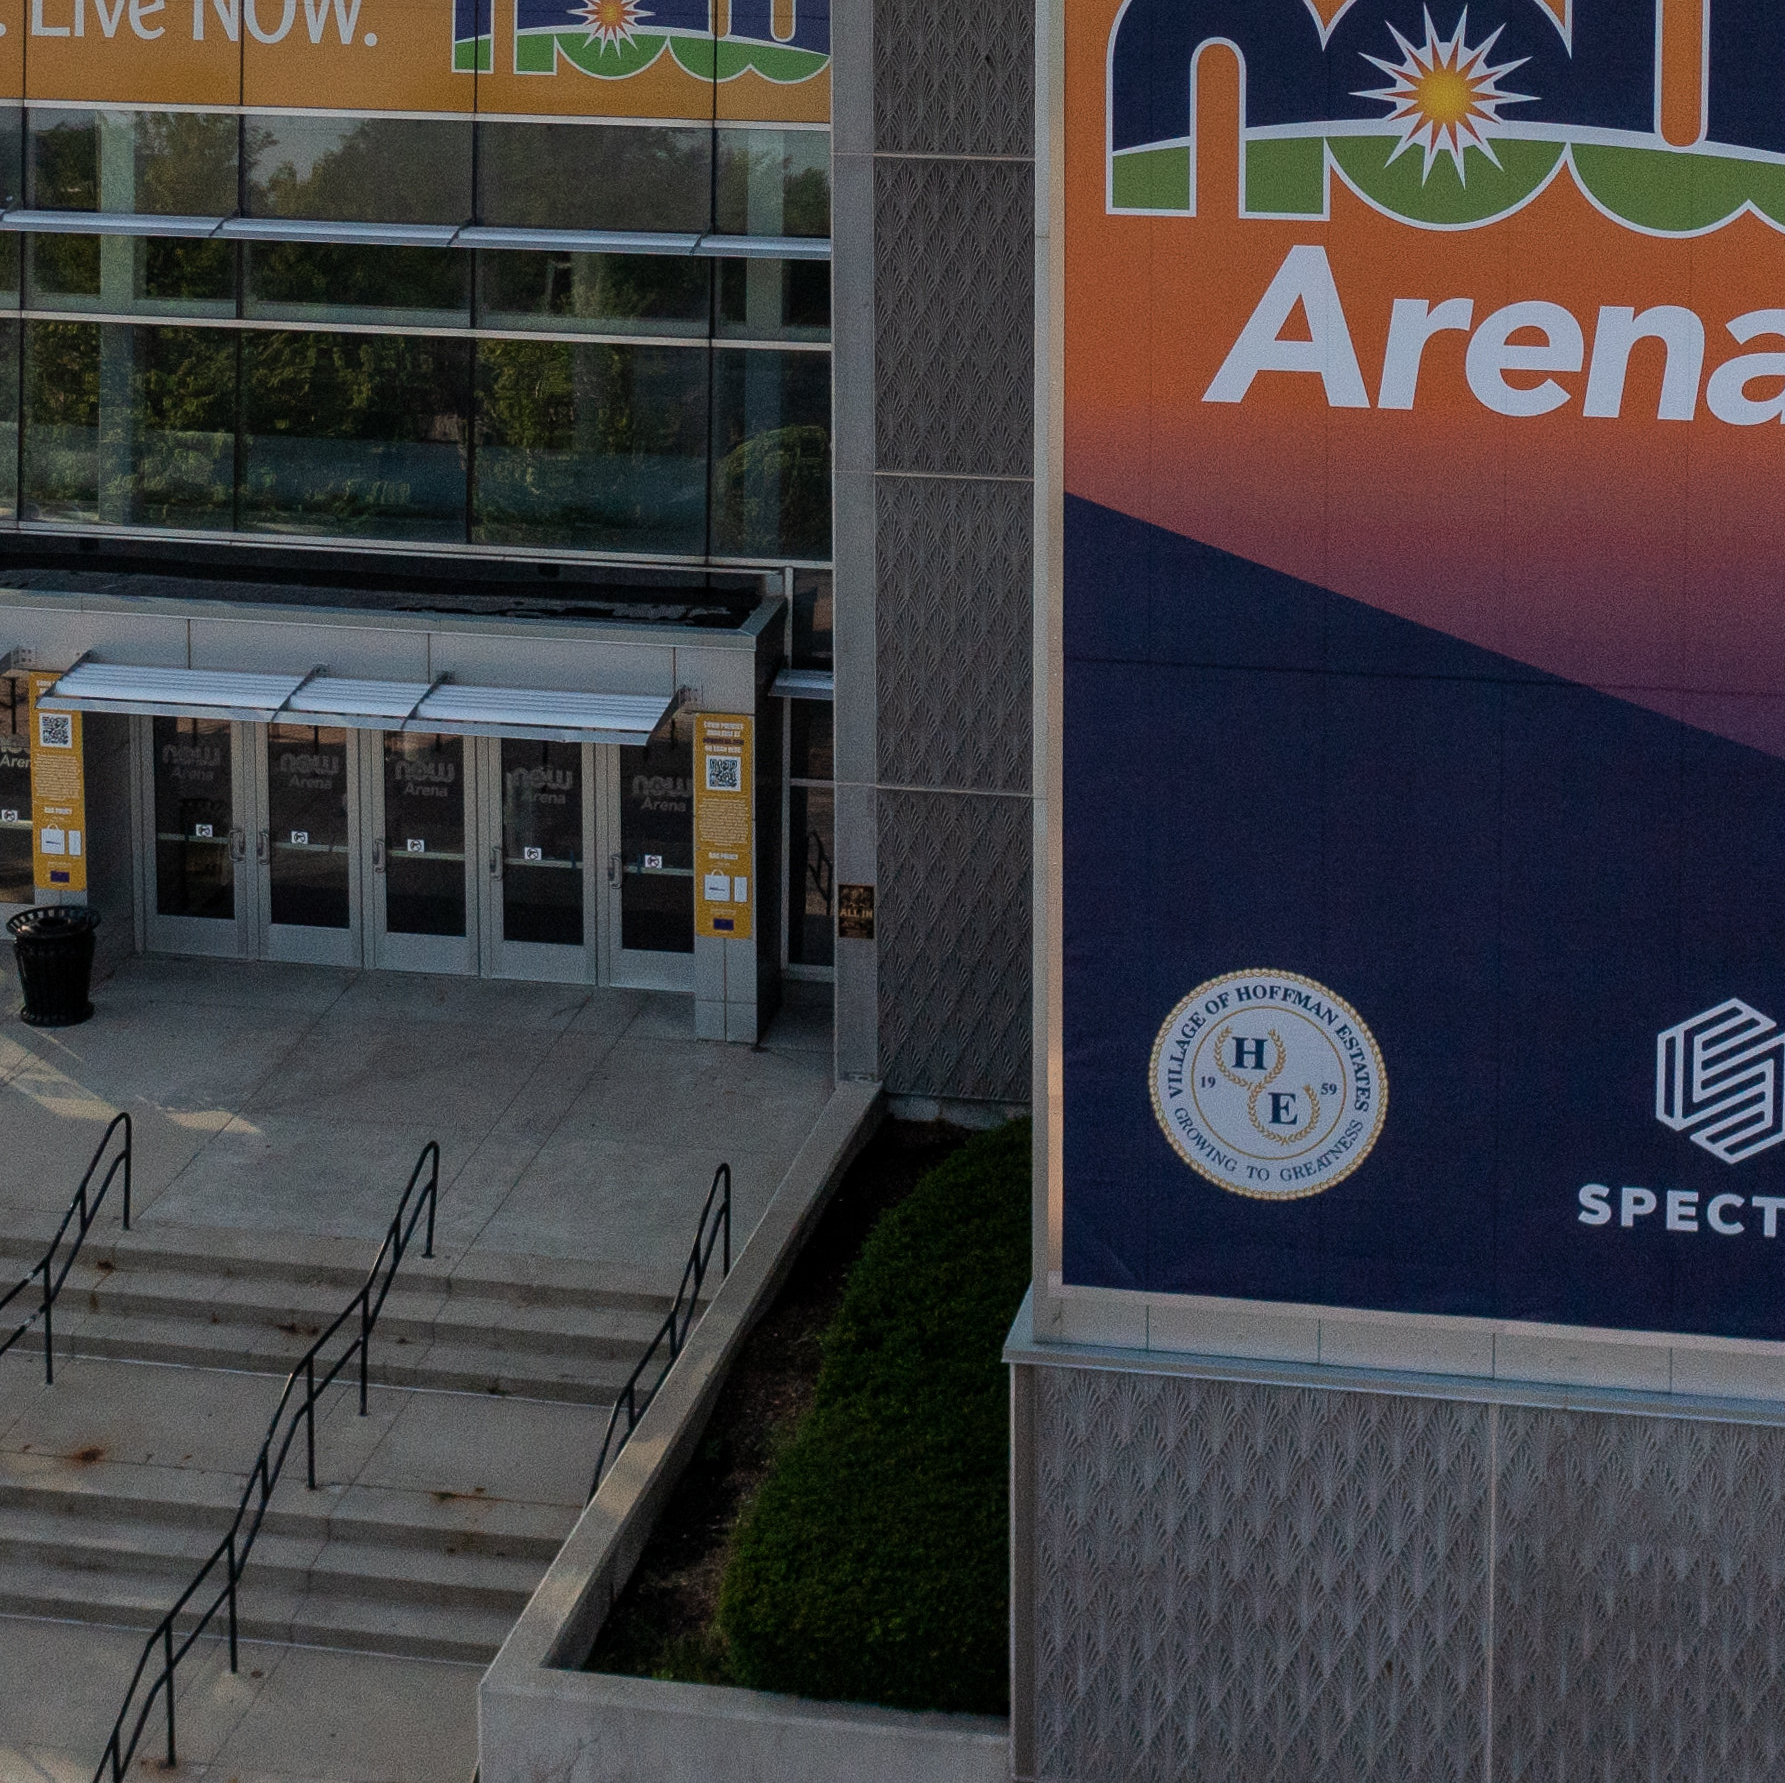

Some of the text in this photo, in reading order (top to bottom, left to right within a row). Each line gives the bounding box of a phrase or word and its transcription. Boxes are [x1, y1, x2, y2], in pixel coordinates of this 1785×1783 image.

[1167, 984, 1371, 1112] VILLAGE OF HOFFMAN ESTATES
[1232, 1037, 1269, 1070] H
[1200, 1075, 1215, 1088] 19
[1320, 1082, 1338, 1096] 59
[1268, 1092, 1298, 1125] E
[1174, 1107, 1364, 1182] GROWING TO GREATNESS
